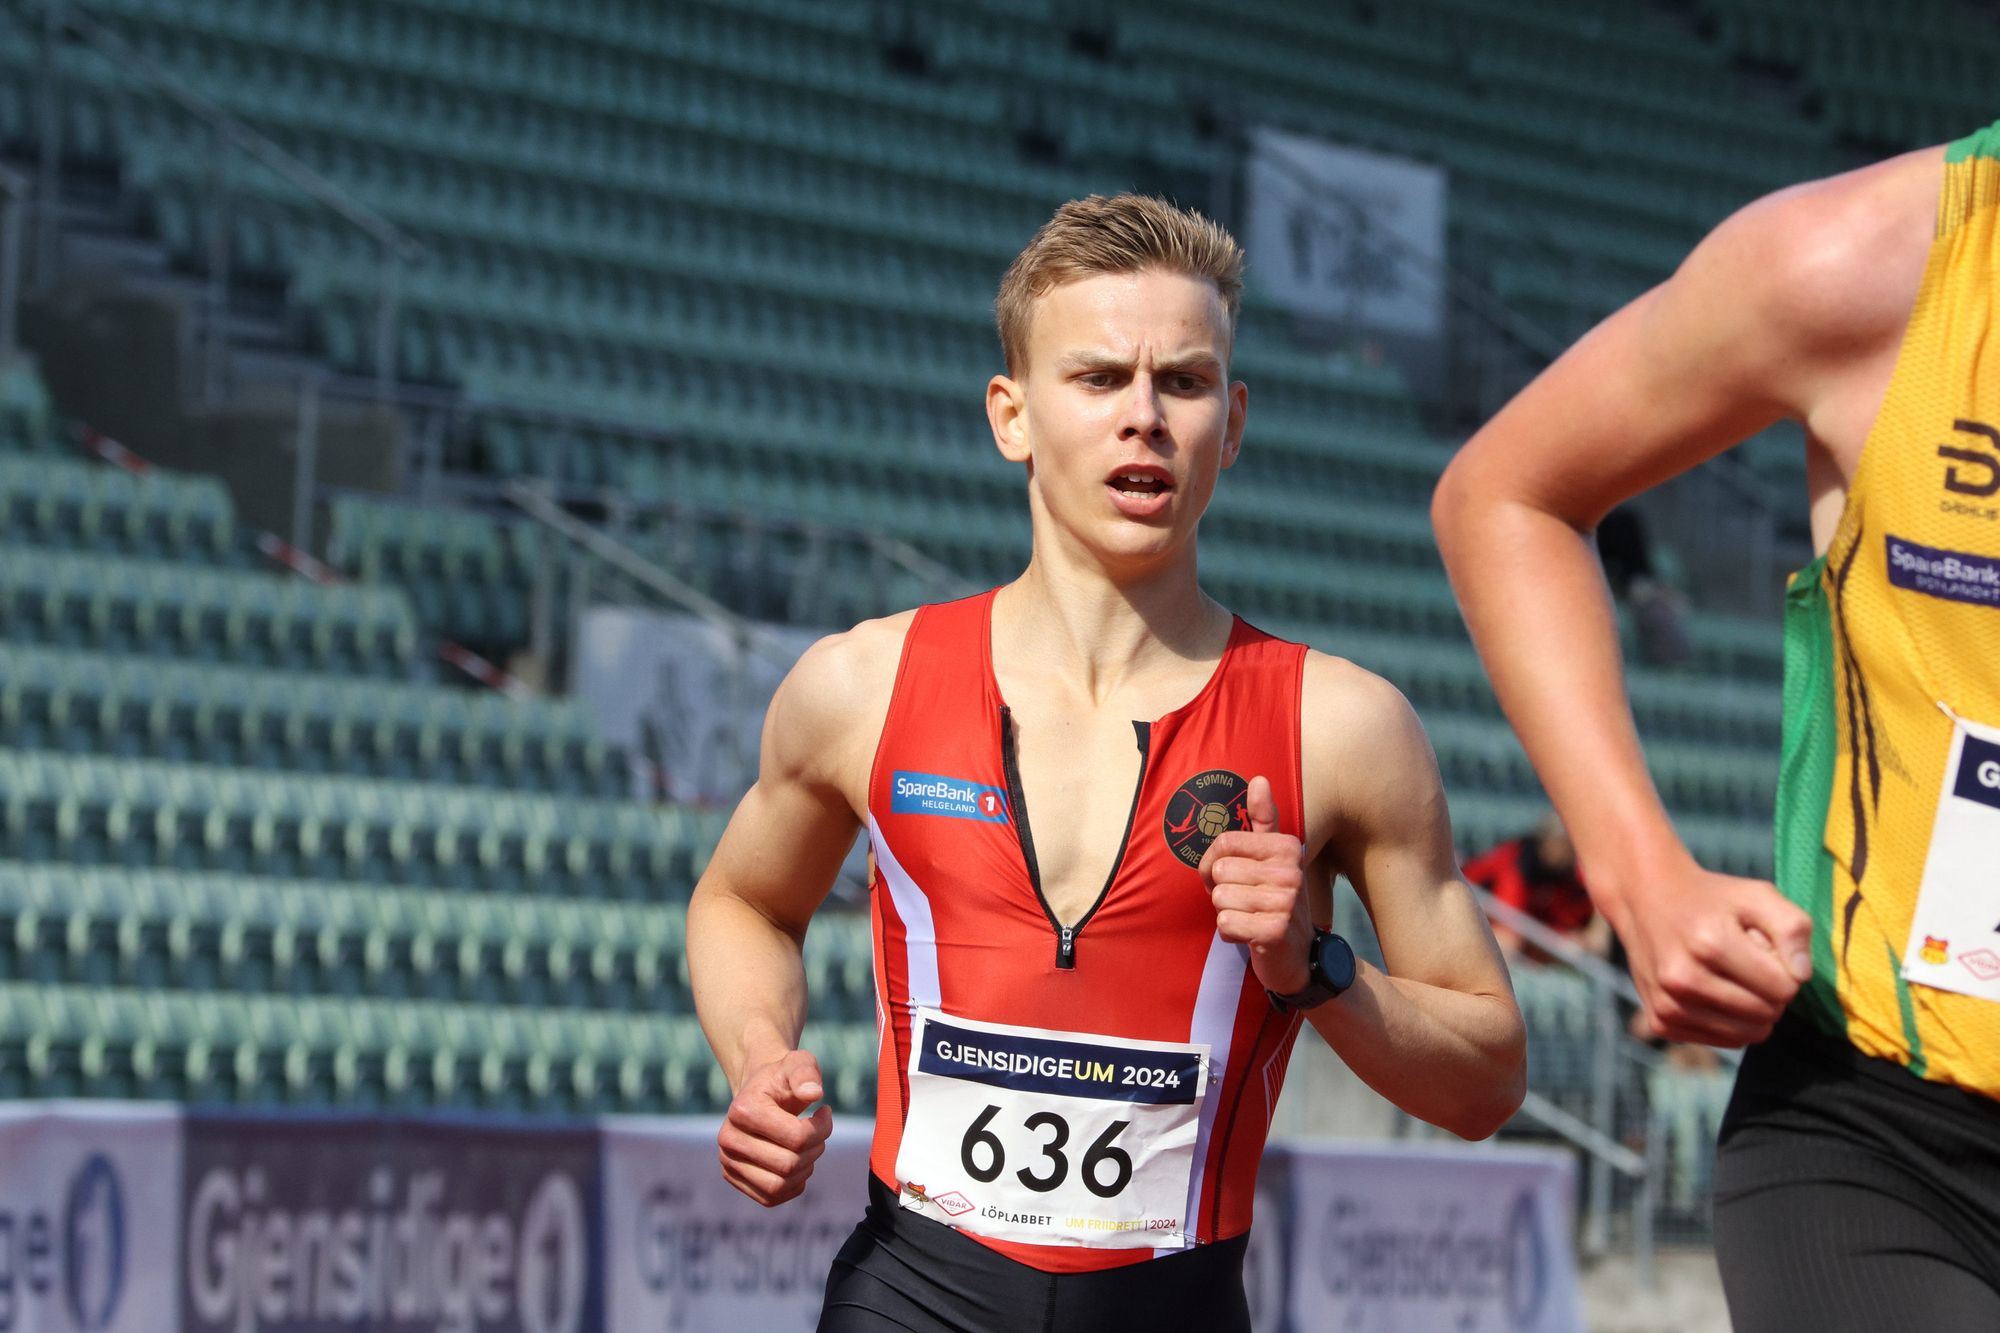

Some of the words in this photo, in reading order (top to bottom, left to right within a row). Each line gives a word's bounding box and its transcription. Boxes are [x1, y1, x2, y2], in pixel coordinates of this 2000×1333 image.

[1195, 773, 1234, 789] SØMNA
[896, 777, 976, 803] SpareBank
[985, 795, 996, 812] 1
[921, 799, 976, 814] HELGELAND
[1179, 844, 1202, 866] IDRE
[936, 1040, 1115, 1083] GJENSIDIGEUM
[1121, 1065, 1181, 1089] 2024
[960, 1104, 1133, 1199] 636
[940, 1197, 967, 1210] VIDAR
[981, 1205, 1052, 1226] LÖPLABBET
[1065, 1217, 1084, 1229] UM
[1087, 1218, 1142, 1232] FRIIDRETT
[1150, 1218, 1177, 1231] 2024
